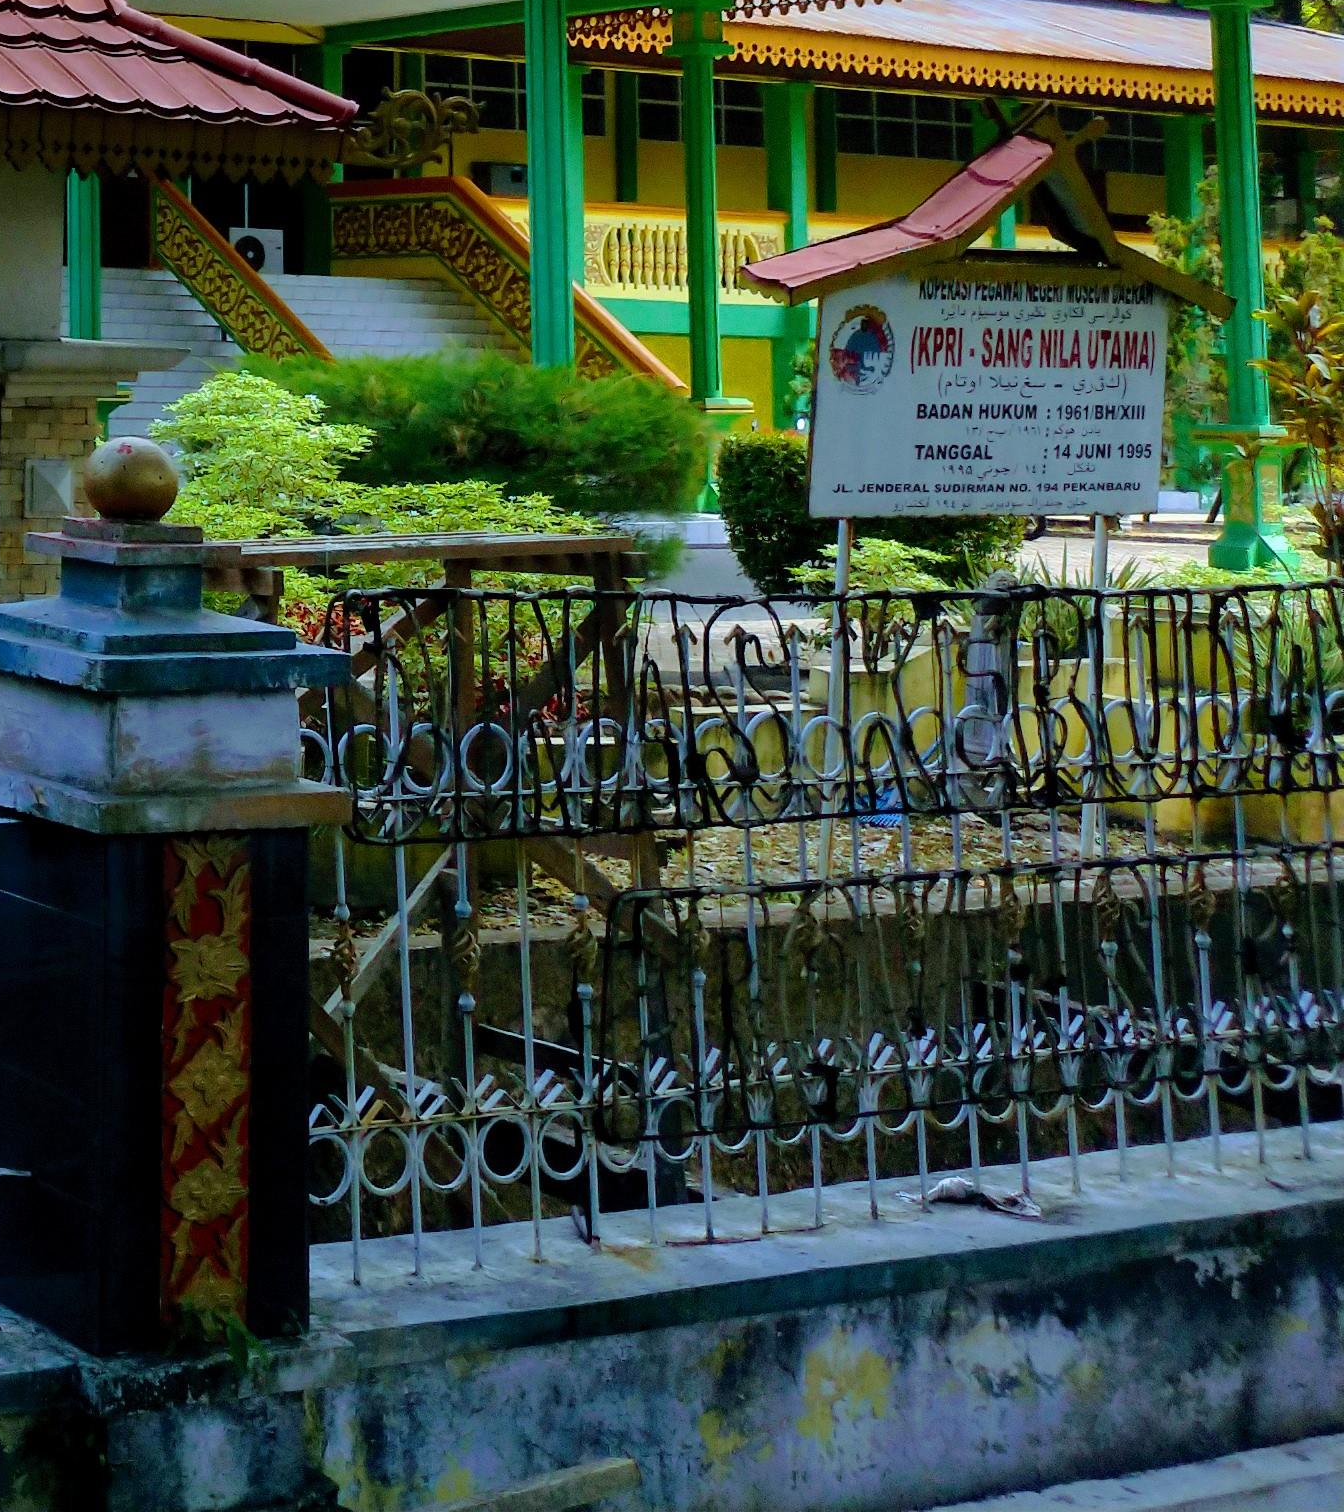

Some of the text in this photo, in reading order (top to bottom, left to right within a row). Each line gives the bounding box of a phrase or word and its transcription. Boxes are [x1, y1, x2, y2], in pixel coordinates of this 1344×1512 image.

[910, 326, 963, 374] (KPRI
[981, 327, 1033, 369] SANG
[1038, 328, 1081, 370] NILA
[1087, 329, 1156, 376] UTAMA)
[916, 403, 973, 420] BADAN
[978, 403, 1038, 420] HUKUM
[1056, 404, 1146, 421] 1961/BH/XIII
[915, 444, 993, 461] TANGGAL
[1054, 444, 1071, 460] 14
[1075, 444, 1111, 460] JUNI
[1117, 443, 1153, 459] 1995
[832, 482, 1141, 494] JL. JENDERAL SUDIRMAN NO. 194 PEKANBARU
